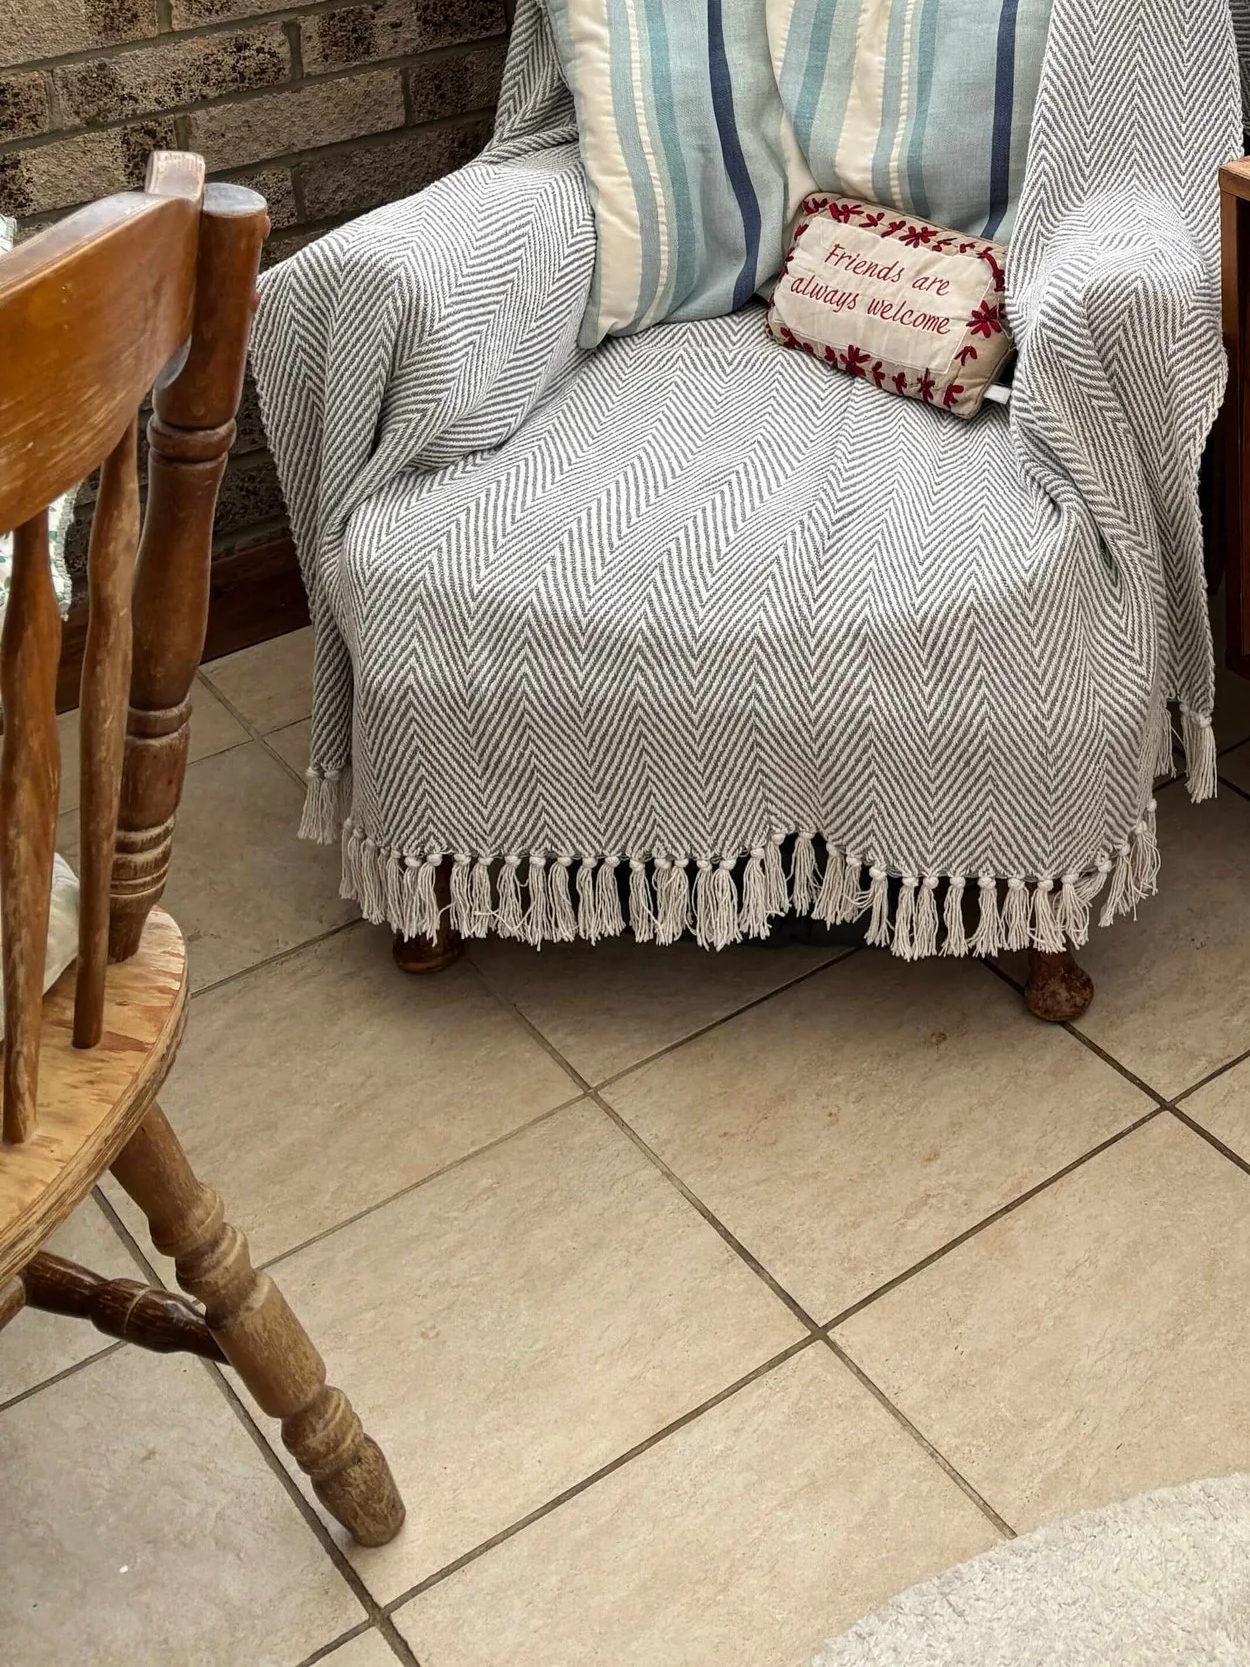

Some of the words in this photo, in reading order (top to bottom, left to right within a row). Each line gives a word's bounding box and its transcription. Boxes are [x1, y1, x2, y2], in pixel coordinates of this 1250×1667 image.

[824, 243, 904, 283] Friends
[912, 275, 950, 296] are
[791, 275, 858, 312] always
[867, 296, 950, 334] welcome
